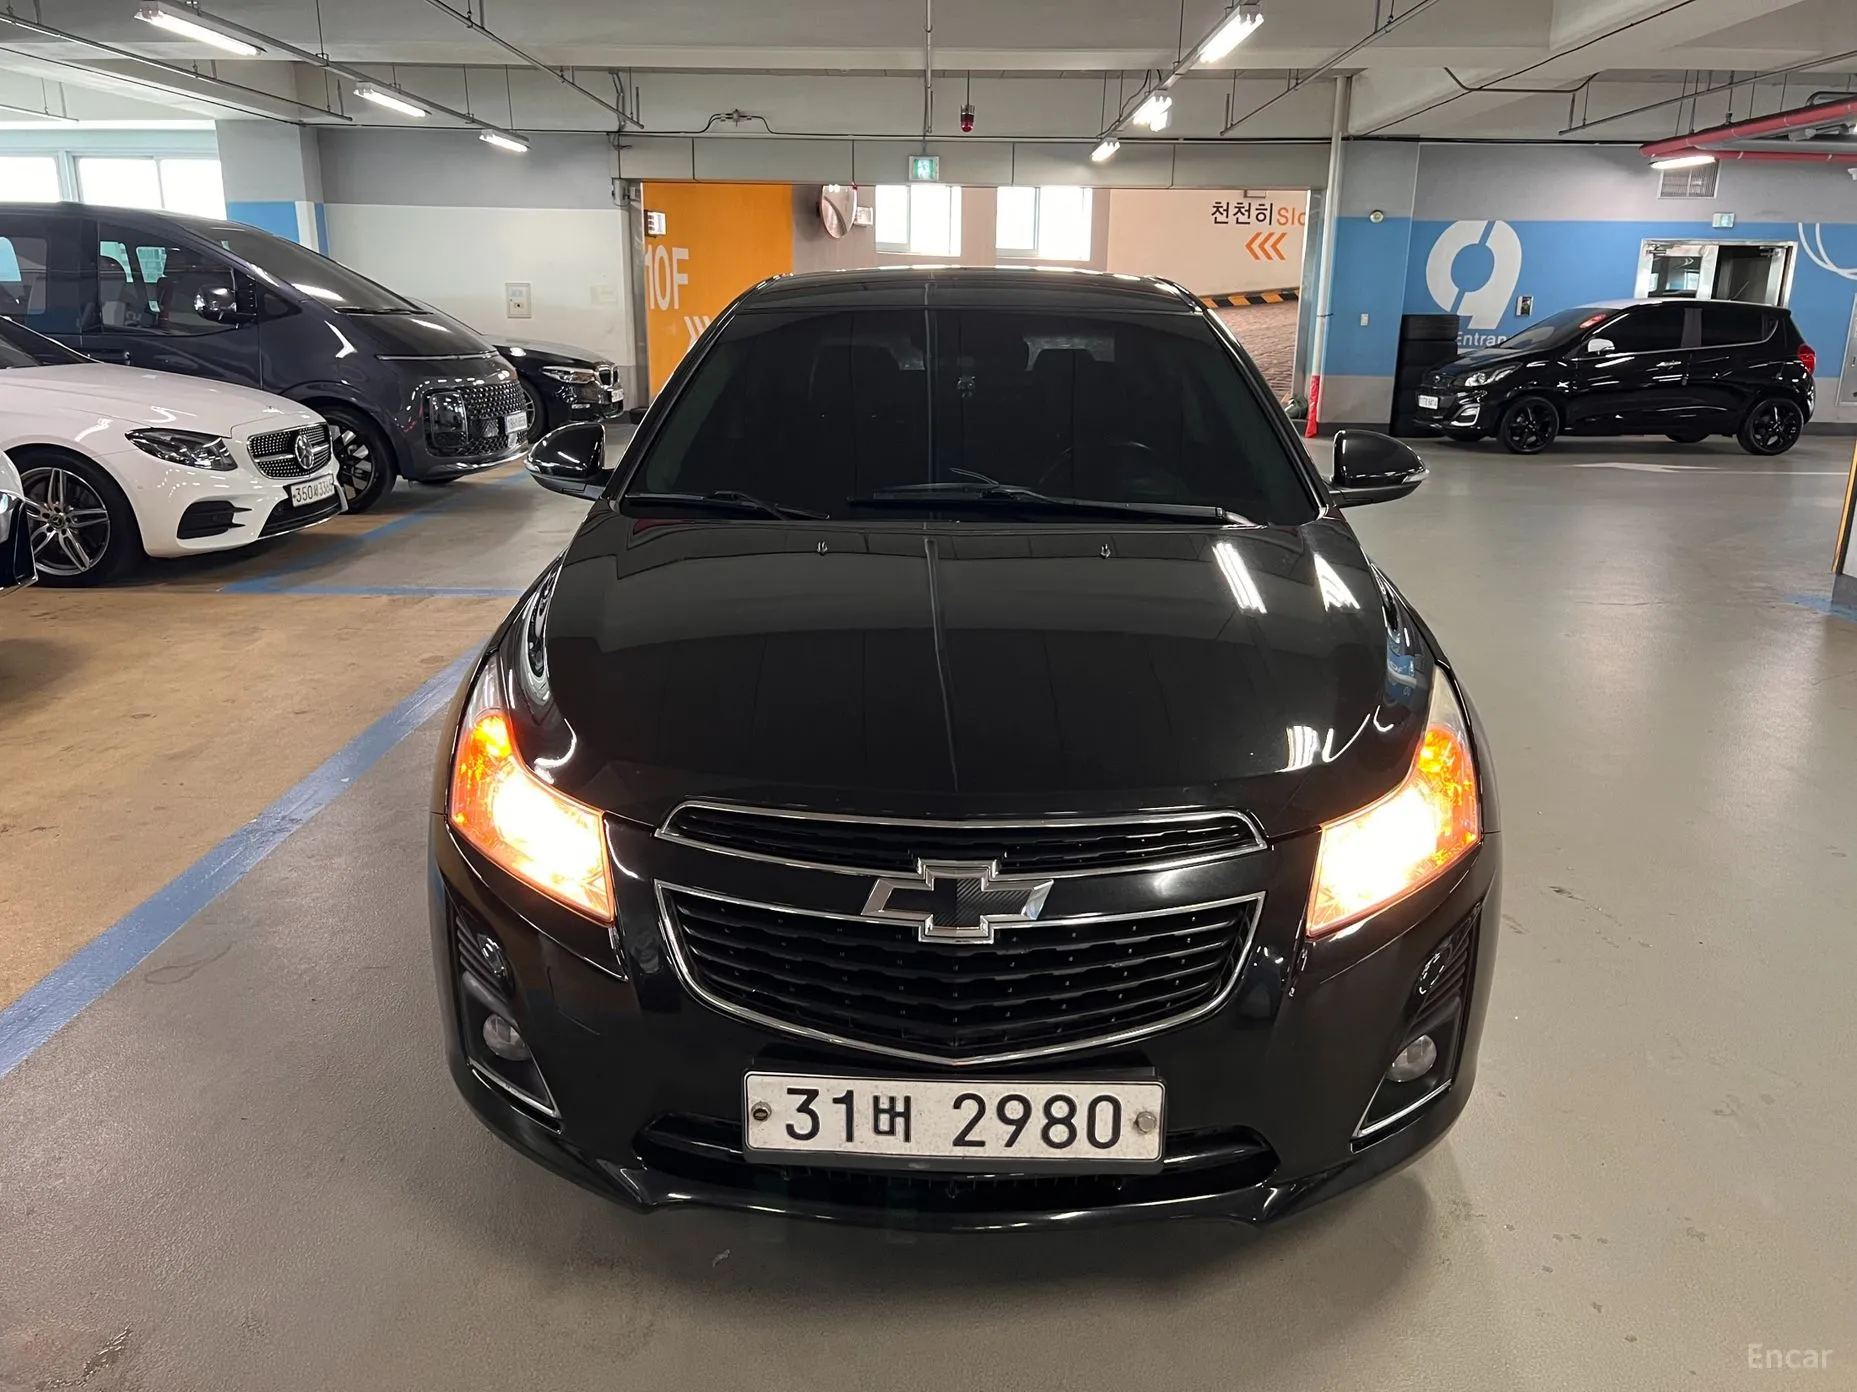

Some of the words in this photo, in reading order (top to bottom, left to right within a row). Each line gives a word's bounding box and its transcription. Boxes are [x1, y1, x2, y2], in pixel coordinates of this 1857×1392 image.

[1211, 201, 1273, 226] 천천히
[644, 244, 689, 310] 10F
[785, 1087, 912, 1143] 31버
[952, 1093, 1122, 1150] 2980
